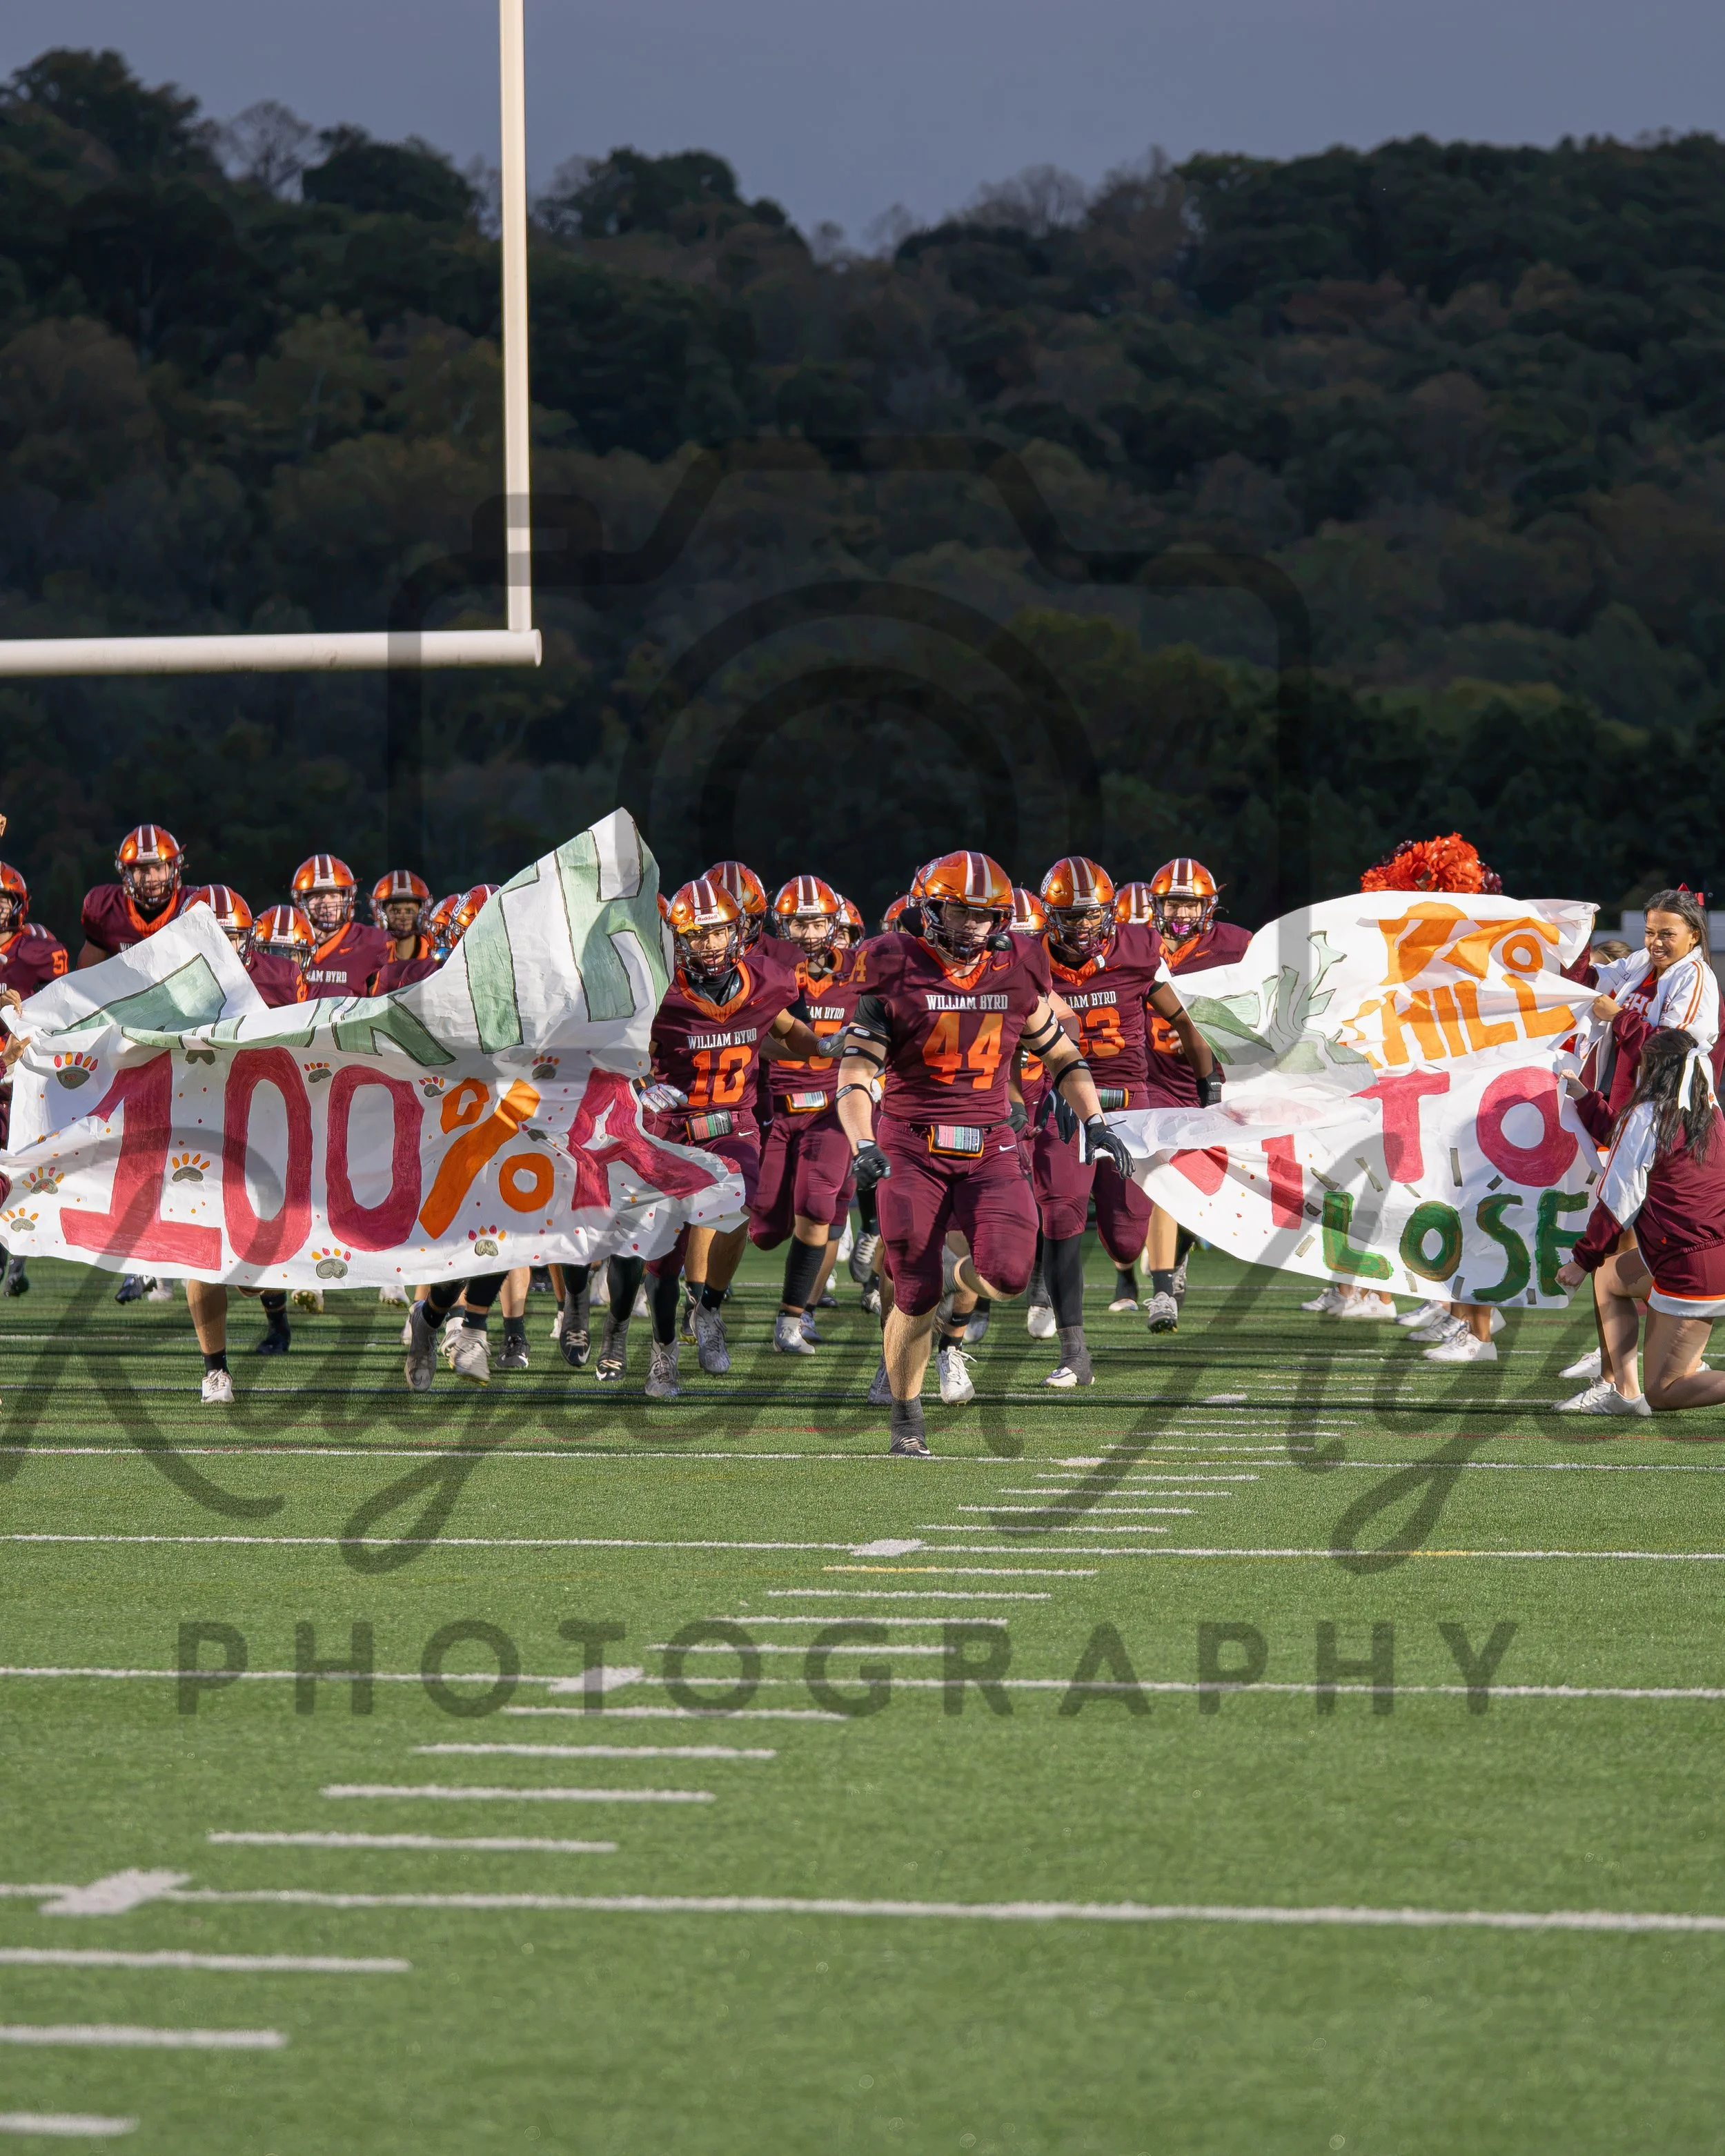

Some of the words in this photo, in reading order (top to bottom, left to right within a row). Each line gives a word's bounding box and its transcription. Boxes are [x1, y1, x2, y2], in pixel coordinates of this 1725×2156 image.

[925, 994, 978, 1010] WILLIAM
[980, 994, 1008, 1010] BYRD
[1091, 991, 1117, 1006] BYRD
[687, 1033, 731, 1049] WILLIAM
[733, 1027, 757, 1045] BYRD
[922, 1011, 1004, 1089] 44
[688, 1045, 752, 1107] 10
[1350, 1066, 1579, 1187] TO
[1322, 1189, 1589, 1303] LOSE
